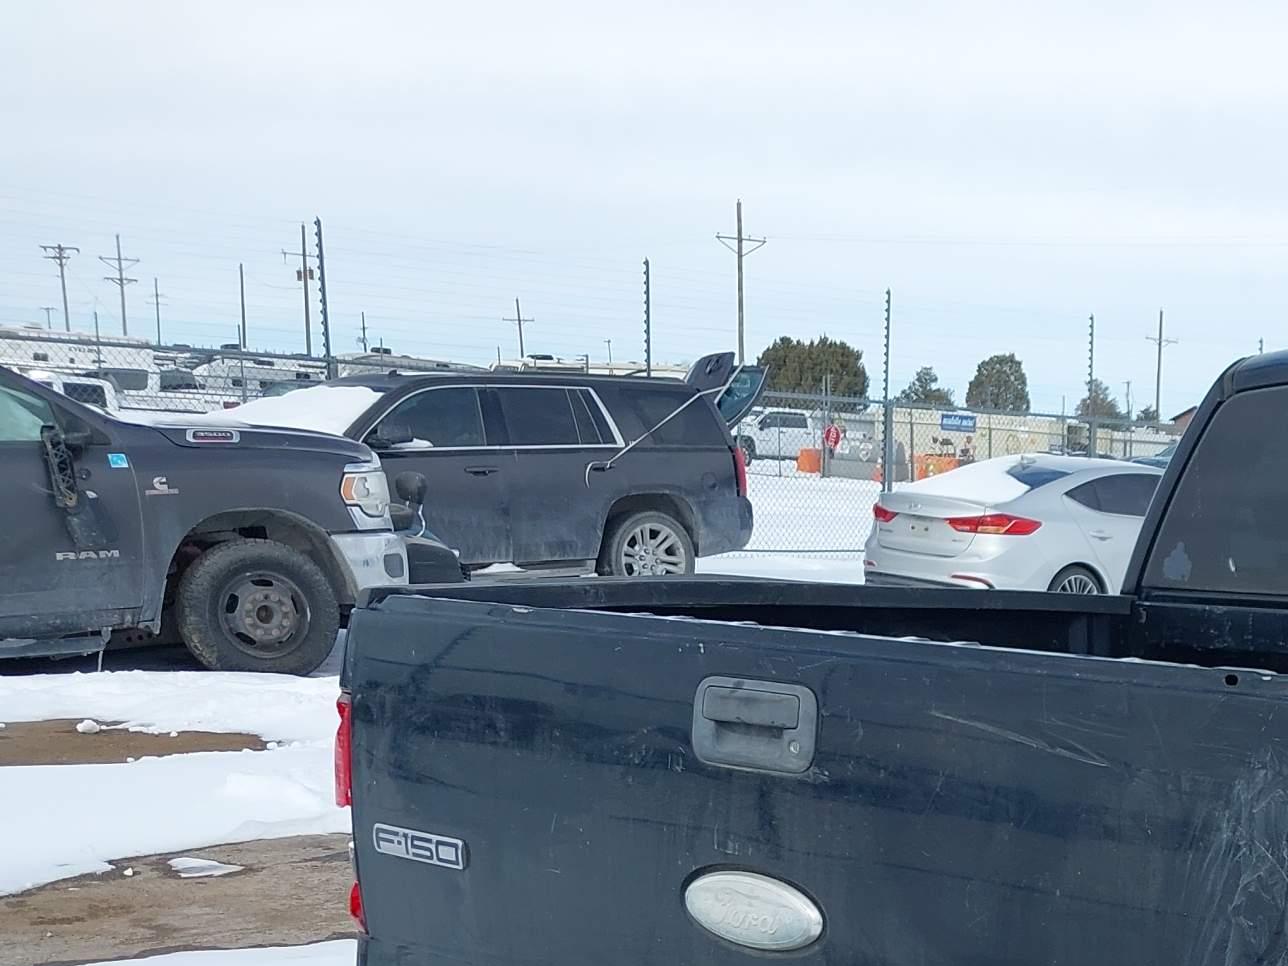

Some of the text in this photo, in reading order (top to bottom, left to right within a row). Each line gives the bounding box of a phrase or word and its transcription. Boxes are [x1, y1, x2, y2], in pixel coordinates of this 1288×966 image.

[56, 550, 120, 560] RAM
[375, 827, 461, 866] F-150
[715, 886, 790, 935] Ford
